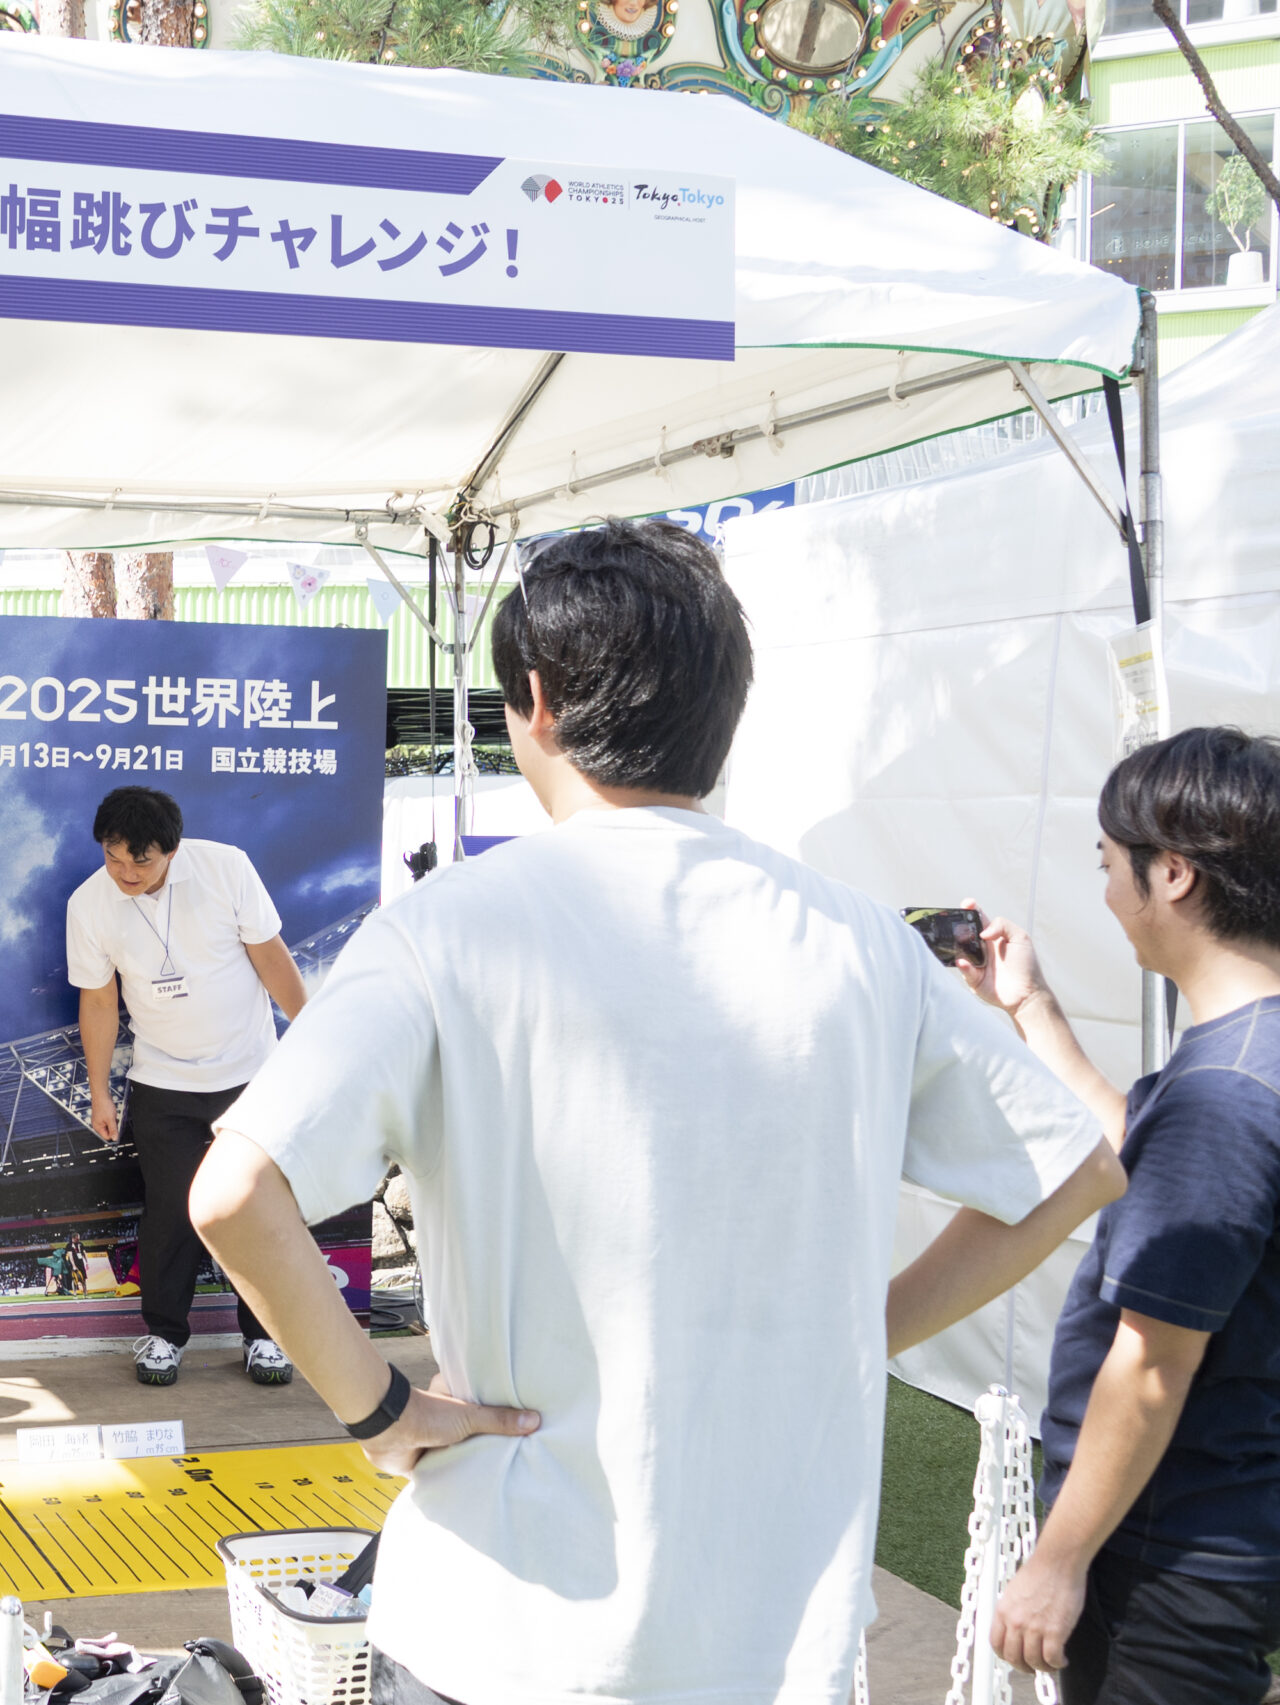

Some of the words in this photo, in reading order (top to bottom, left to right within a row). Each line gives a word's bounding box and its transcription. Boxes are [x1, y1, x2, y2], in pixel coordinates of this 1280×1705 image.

[567, 181, 593, 189] WORLD
[594, 182, 624, 191] ATHLETICS
[568, 188, 624, 197] CHAMPIONSHIPS
[678, 188, 724, 209] Tokyo
[210, 746, 338, 775] 国立競技場
[157, 984, 182, 993] STAFF
[112, 1430, 138, 1444] 竹脇
[146, 1428, 174, 1442] まりな
[292, 1477, 313, 1486] 20
[332, 1475, 353, 1483] 30
[82, 1494, 102, 1503] 70
